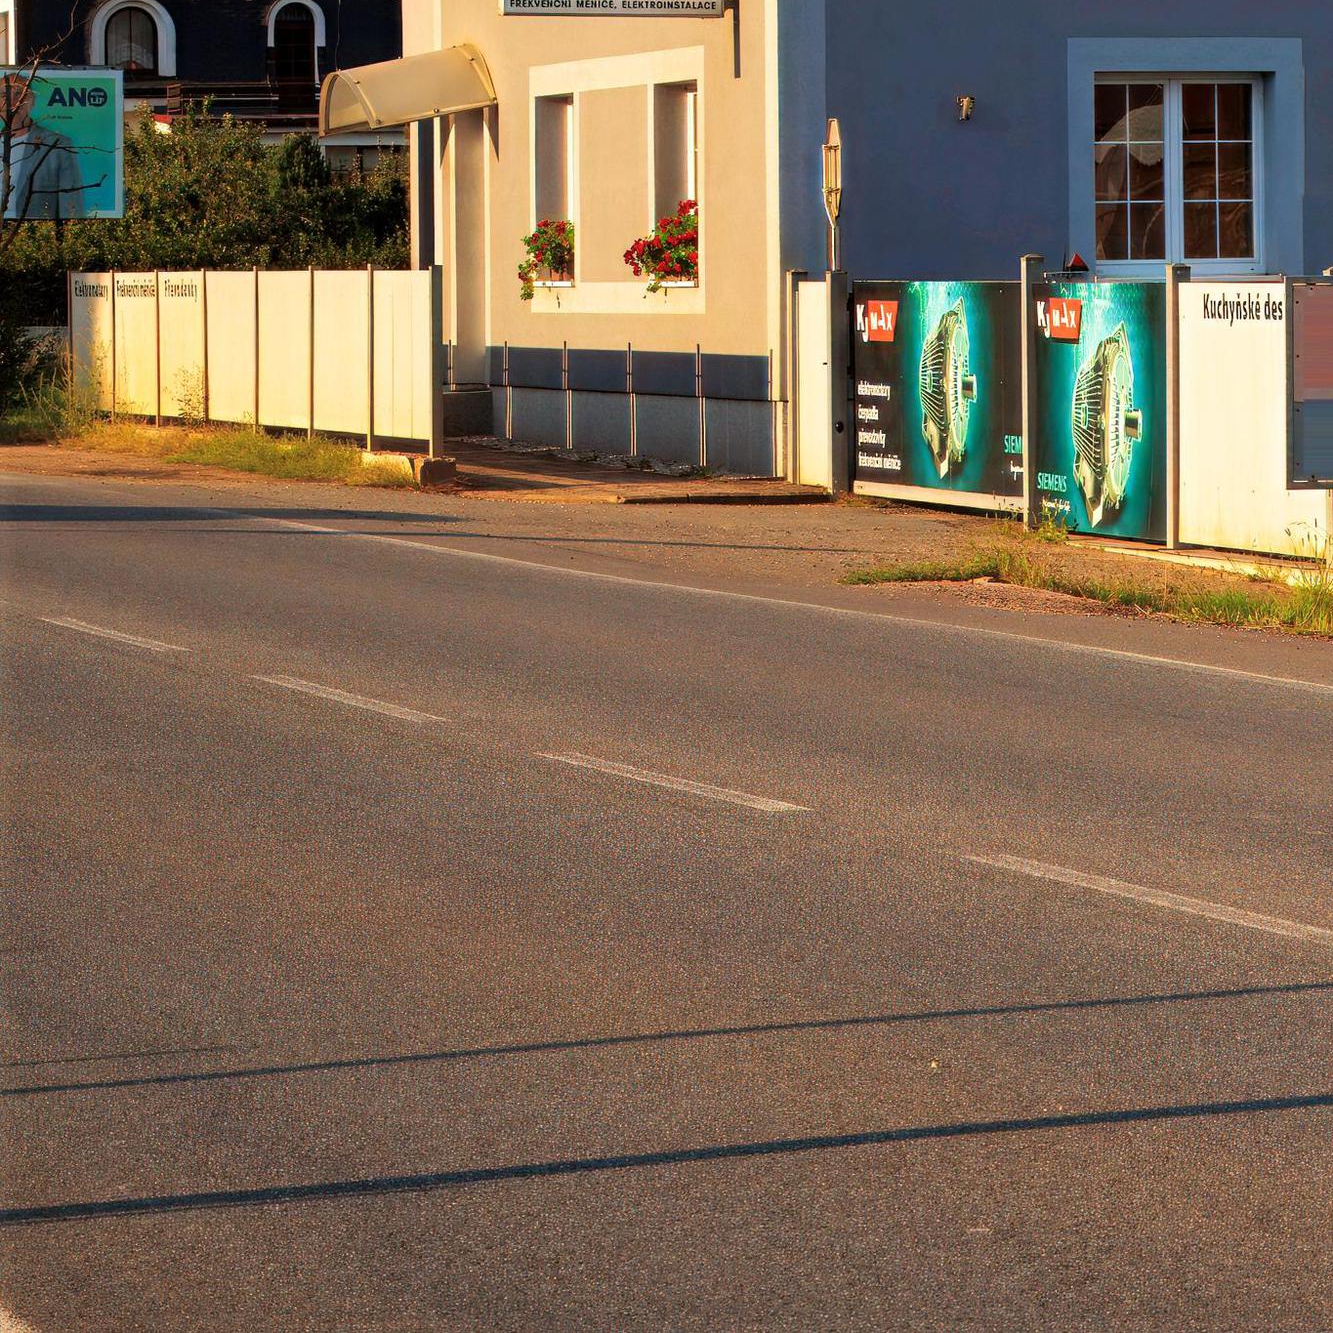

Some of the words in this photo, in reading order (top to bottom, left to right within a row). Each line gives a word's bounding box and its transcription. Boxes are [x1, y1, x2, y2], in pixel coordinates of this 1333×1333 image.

[622, 0, 717, 11] ELEKTROINSTALACE
[48, 87, 108, 107] ANO
[1036, 300, 1050, 339] KJ
[1203, 292, 1261, 327] Kuchyňské
[1264, 292, 1283, 321] des
[856, 304, 870, 343] KJ
[1003, 434, 1024, 454] SIEM
[1037, 471, 1068, 493] SIEMENS
